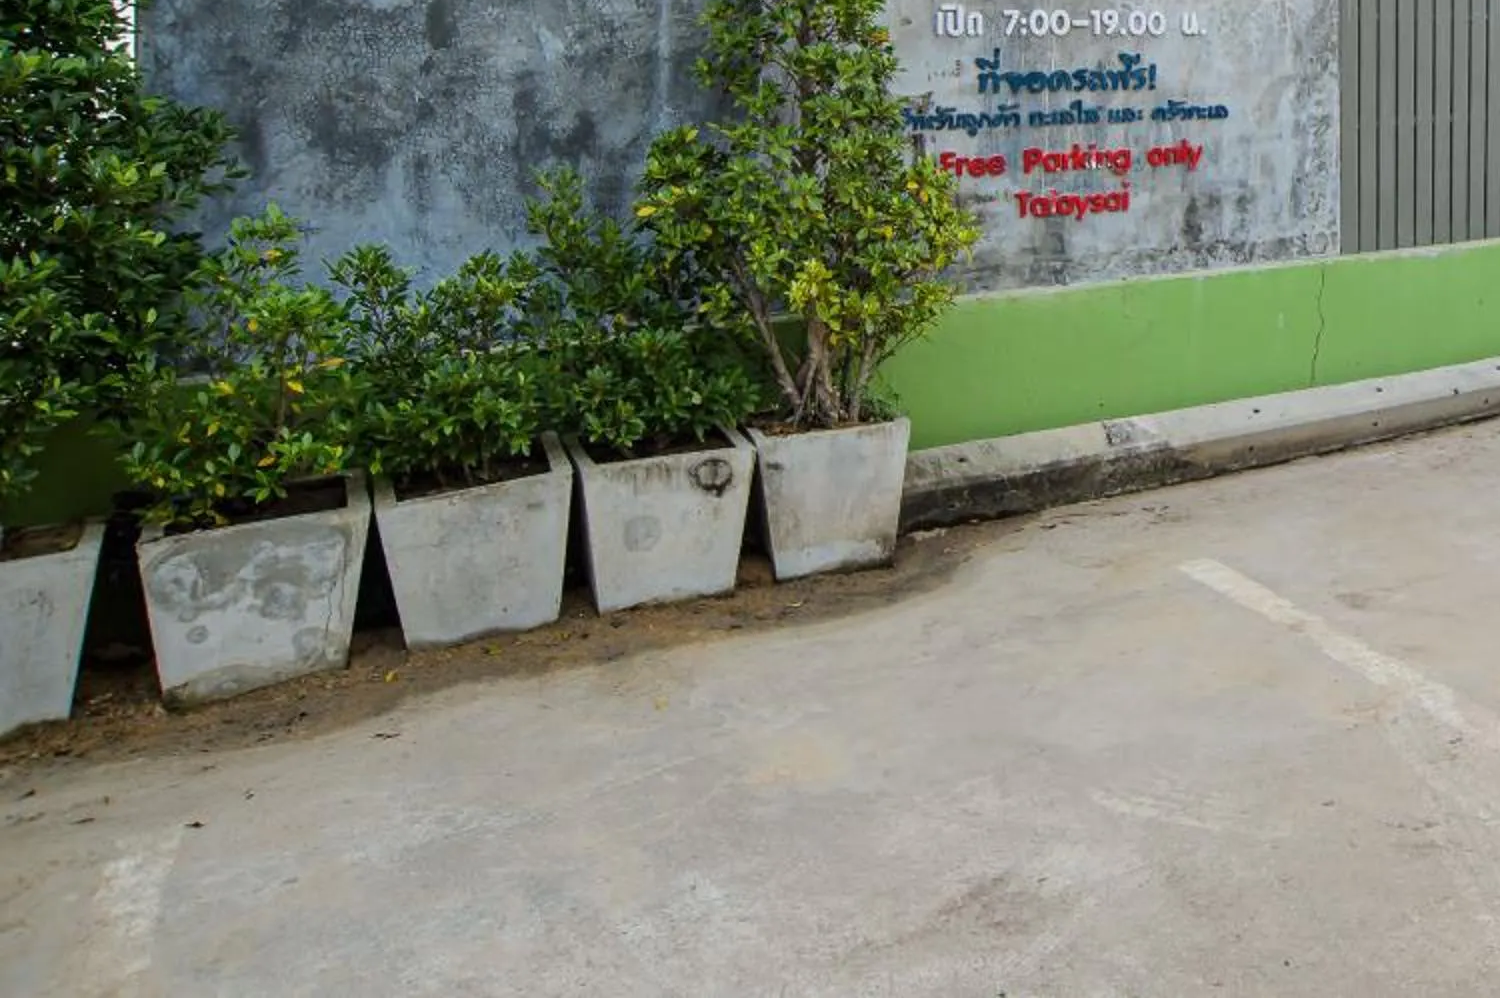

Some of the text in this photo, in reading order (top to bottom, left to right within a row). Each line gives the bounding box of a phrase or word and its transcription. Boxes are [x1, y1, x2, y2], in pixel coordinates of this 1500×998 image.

[935, 3, 1208, 37] เปิด 7:00-19.00 น.
[939, 138, 1205, 179] Free Parking only
